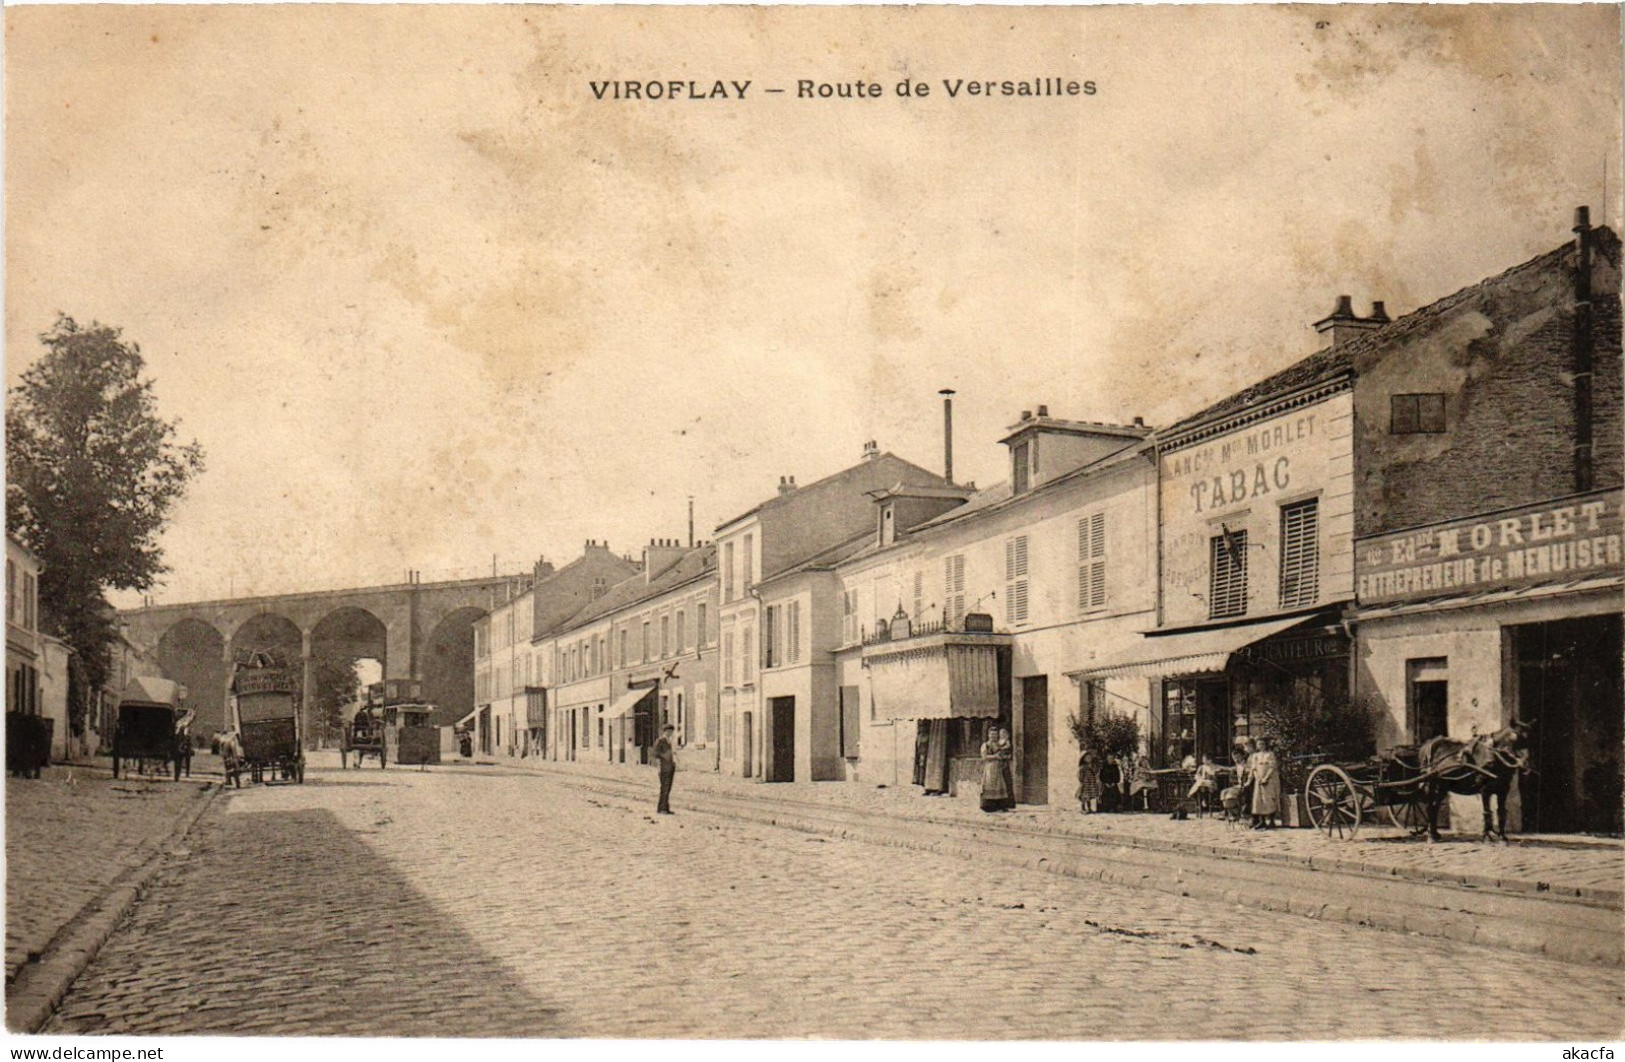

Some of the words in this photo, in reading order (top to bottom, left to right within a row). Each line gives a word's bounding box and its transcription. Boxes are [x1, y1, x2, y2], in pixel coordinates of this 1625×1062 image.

[1247, 414, 1317, 455] MORLET
[1189, 455, 1291, 515] TABAC
[1437, 501, 1606, 557] MORLET
[1358, 558, 1477, 601] ENTREPRENEUR
[1480, 556, 1503, 581] de
